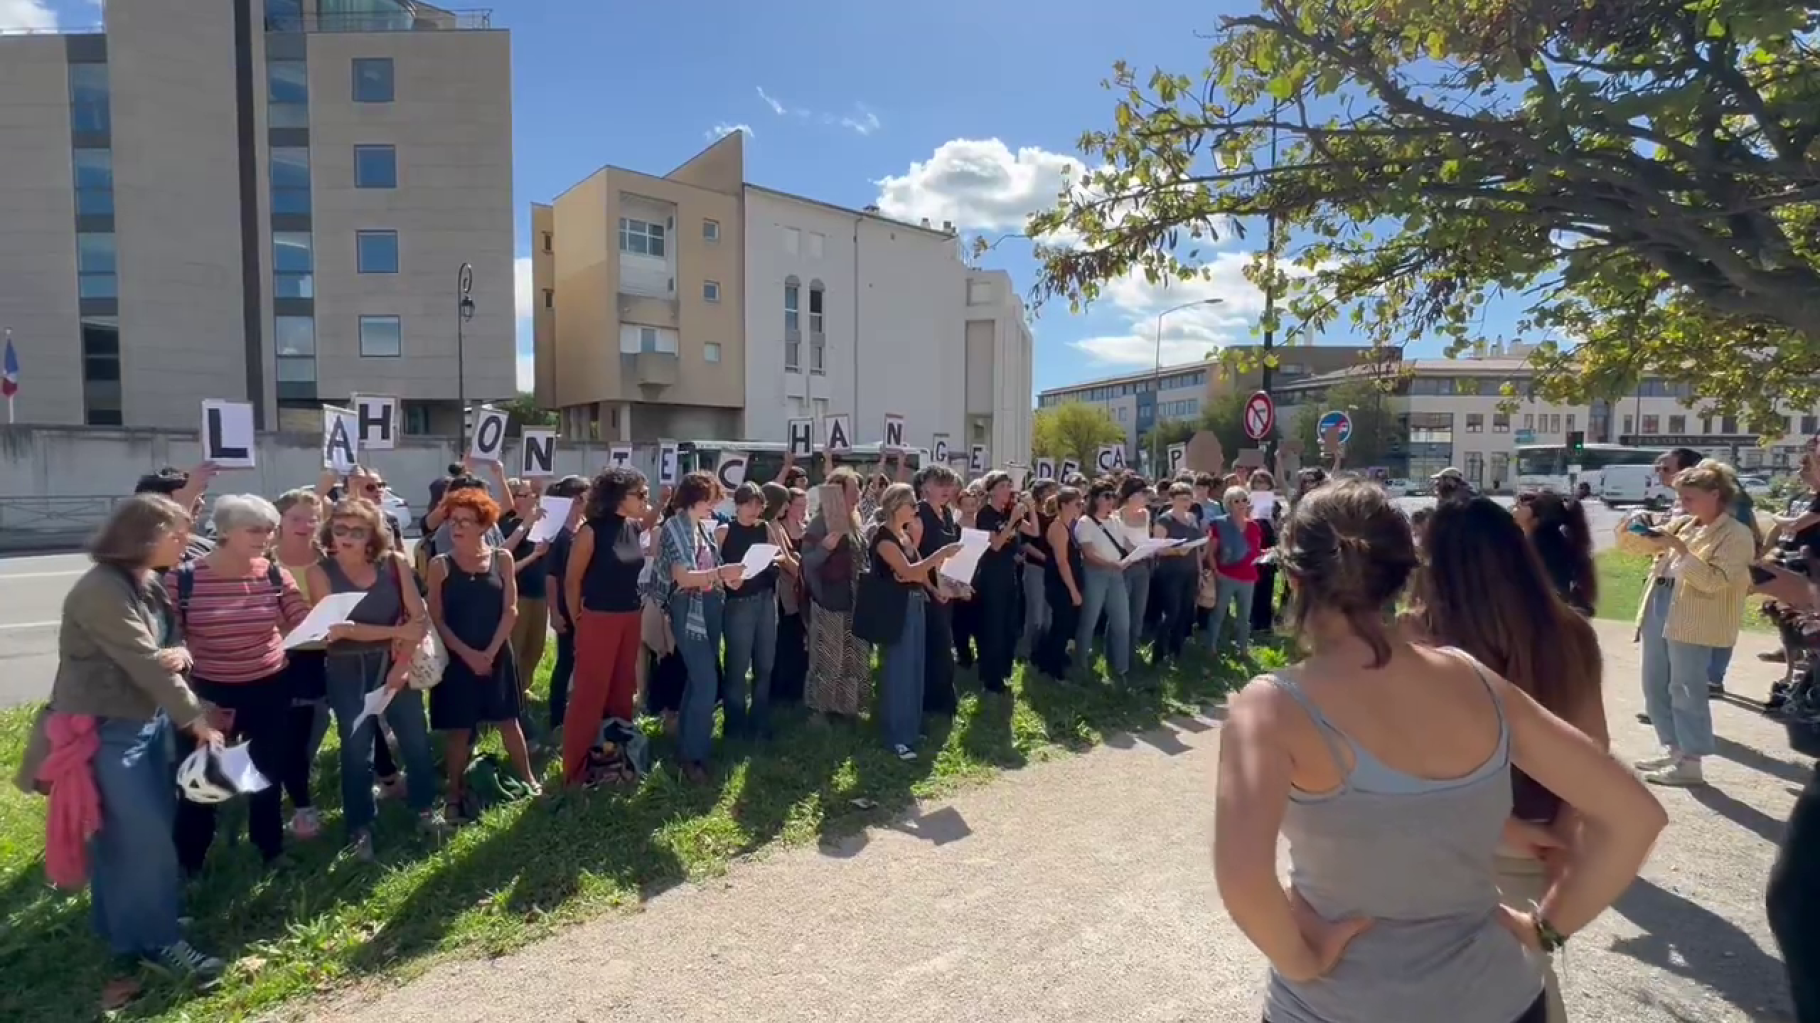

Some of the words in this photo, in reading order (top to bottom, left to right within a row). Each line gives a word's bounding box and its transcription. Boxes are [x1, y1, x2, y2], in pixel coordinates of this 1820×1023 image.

[208, 408, 248, 458] L
[359, 404, 391, 439] H
[478, 415, 502, 453] O
[829, 419, 848, 448] A
[887, 422, 902, 445] N
[327, 415, 354, 463] A
[792, 424, 809, 453] H
[936, 441, 946, 461] G
[525, 437, 554, 471] N
[661, 448, 673, 479] E
[971, 447, 982, 468] E
[1099, 451, 1111, 470] C
[1113, 449, 1124, 467] A
[1171, 451, 1182, 470] P
[718, 459, 743, 489] C
[1040, 463, 1051, 479] D
